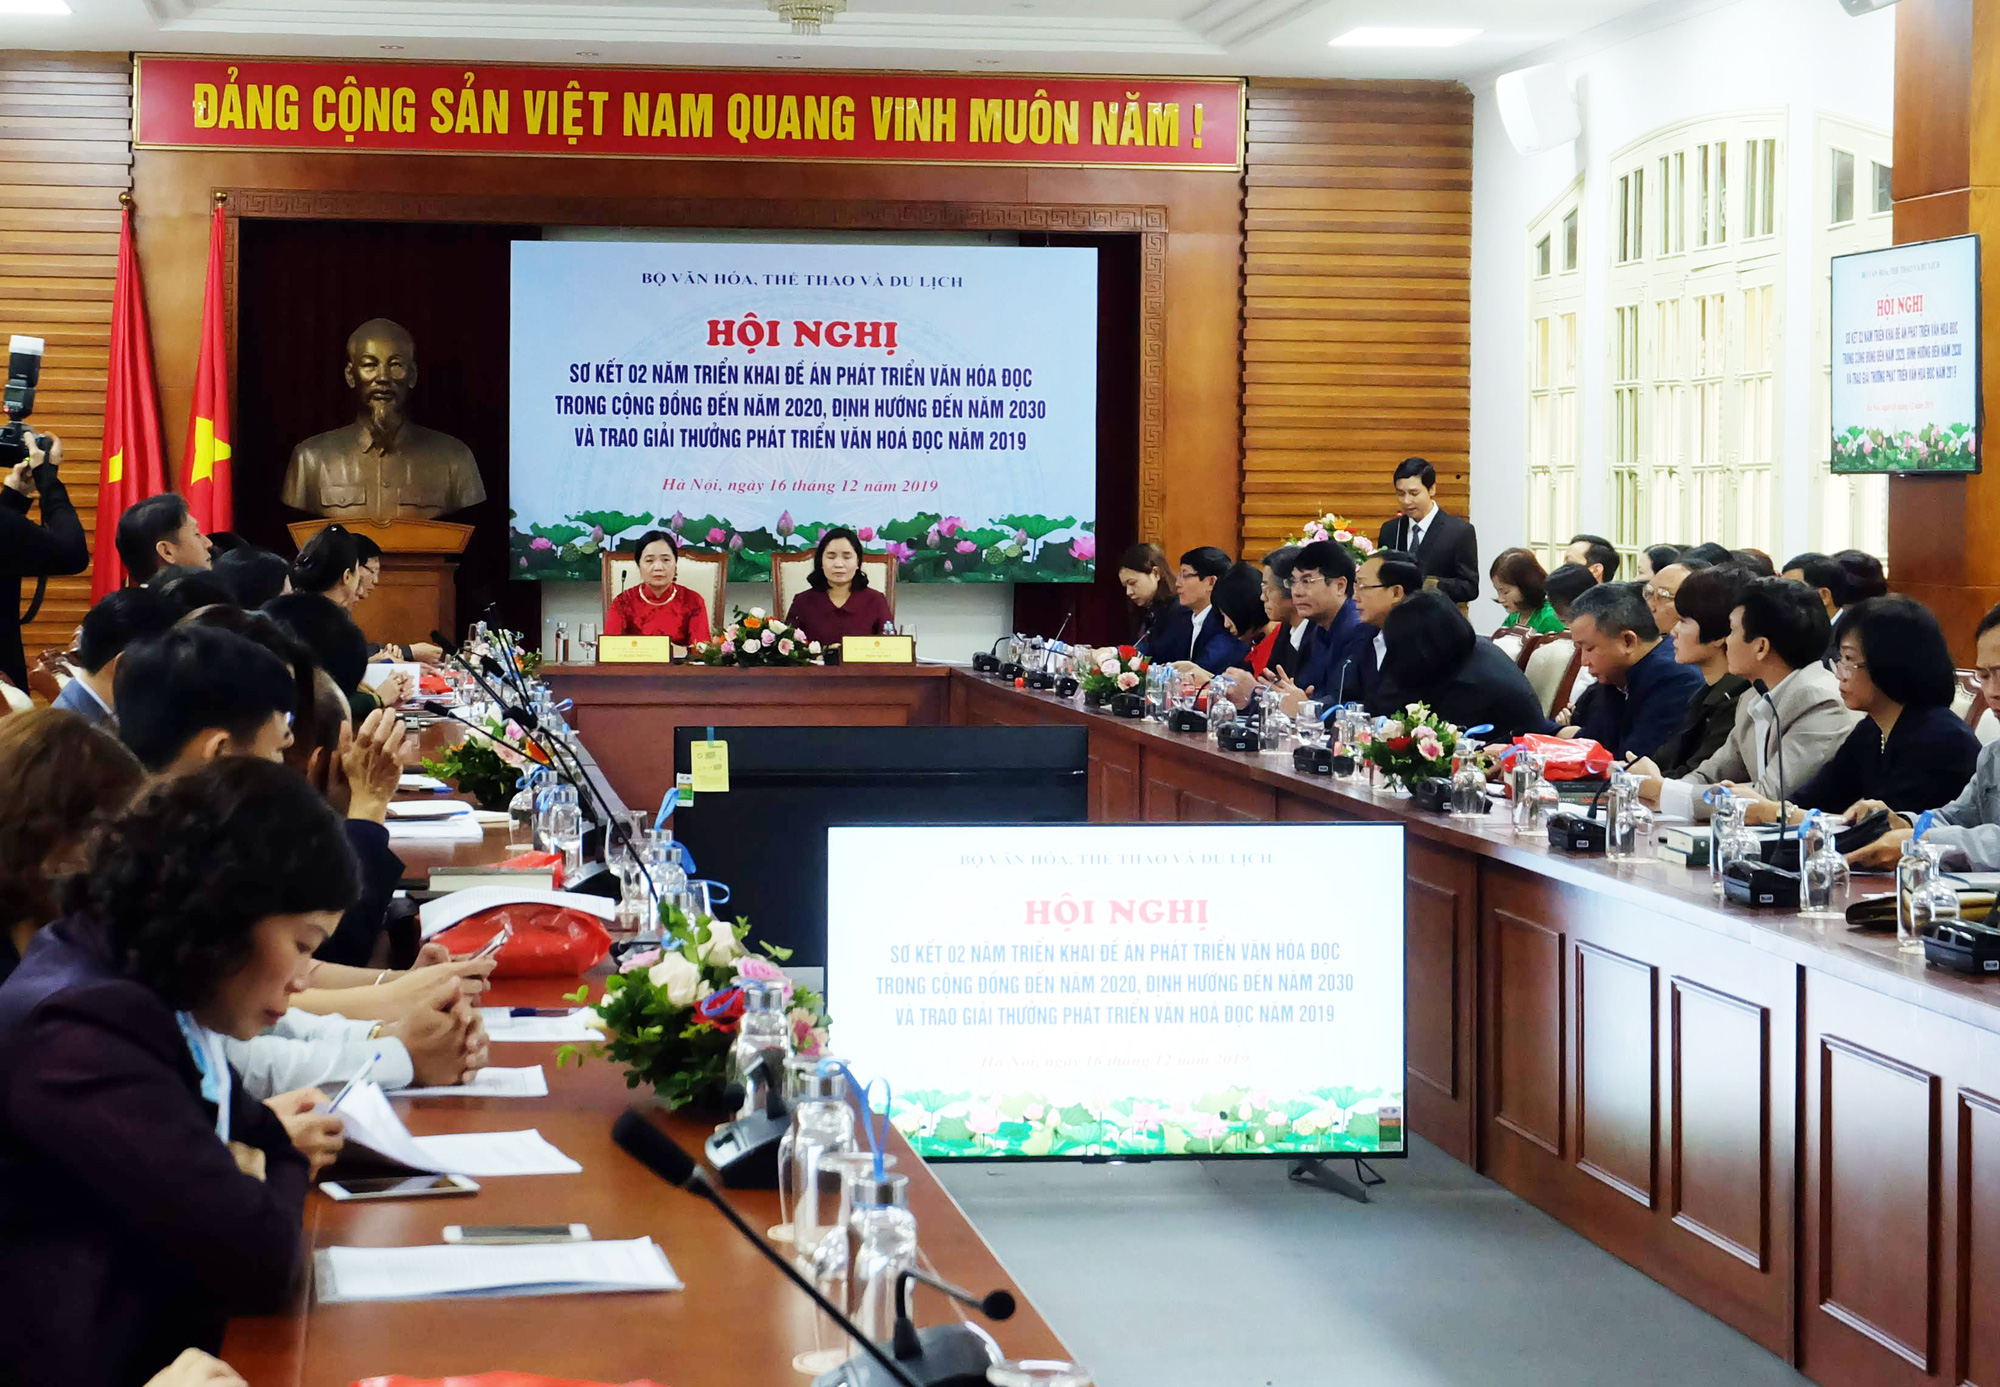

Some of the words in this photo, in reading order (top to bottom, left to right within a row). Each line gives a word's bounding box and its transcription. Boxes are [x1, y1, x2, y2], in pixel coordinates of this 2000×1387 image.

[193, 66, 299, 129] ĐẢNG
[312, 76, 417, 142] CỘNG
[430, 71, 509, 134] SẢN
[523, 80, 609, 145] VIỆT
[623, 92, 713, 138] NAM
[727, 92, 855, 145] QUANG
[871, 97, 956, 142] VINH
[969, 88, 1079, 145] MUÔN
[1092, 91, 1179, 147] NĂM
[1192, 103, 1203, 149] !
[642, 272, 666, 286] BỘ
[672, 271, 707, 284] VĂN
[715, 270, 757, 285] HÓA,
[804, 275, 855, 286] THAO
[860, 273, 883, 286] VÀ
[890, 276, 913, 287] DU
[920, 277, 962, 290] LỊCH
[1877, 293, 1894, 320] HỘI
[1897, 295, 1923, 316] NGHỊ
[706, 312, 781, 354] HỘI
[793, 320, 898, 356] NGHỊ
[570, 362, 591, 383] SƠ
[595, 357, 624, 383] KẾT
[628, 364, 647, 383] 02
[652, 362, 688, 384] NĂM
[693, 357, 738, 384] TRIỂN
[744, 365, 779, 385] KHAI
[785, 359, 804, 385] ĐỀ
[810, 362, 831, 385] ÁN
[837, 364, 876, 386] PHÁT
[881, 359, 925, 386] TRIỂN
[930, 365, 960, 387] VĂN
[966, 364, 997, 387] HÓA
[1002, 368, 1032, 390] ĐỌC
[555, 395, 606, 415] TRONG
[612, 392, 654, 419] CỘNG
[659, 390, 702, 416] ĐỒNG
[707, 391, 738, 416] ĐẾN
[744, 394, 779, 416] NĂM
[785, 398, 827, 419] 2020,
[832, 398, 869, 421] ĐỊNH
[875, 395, 927, 418] HƯỚNG
[932, 393, 963, 418] ĐẾN
[968, 396, 1004, 418] NĂM
[1009, 400, 1046, 419] 2030
[575, 423, 594, 447] VÀ
[599, 427, 638, 447] TRAO
[644, 422, 674, 447] GIẢI
[679, 422, 741, 448] THƯỞNG
[747, 425, 786, 448] PHÁT
[791, 422, 835, 449] TRIỂN
[840, 426, 871, 449] VĂN
[877, 426, 907, 450] HOÁ
[912, 430, 943, 453] ĐỌC
[949, 427, 984, 450] NĂM
[989, 431, 1026, 451] 2019
[662, 478, 686, 491] Hà
[727, 479, 765, 494] ngày
[770, 479, 787, 492] 16
[792, 479, 836, 495] tháng
[841, 479, 859, 492] 12
[864, 481, 897, 492] năm
[902, 480, 939, 492] 2019
[1025, 892, 1094, 932] HỘI
[1109, 899, 1208, 931] NGHỊ
